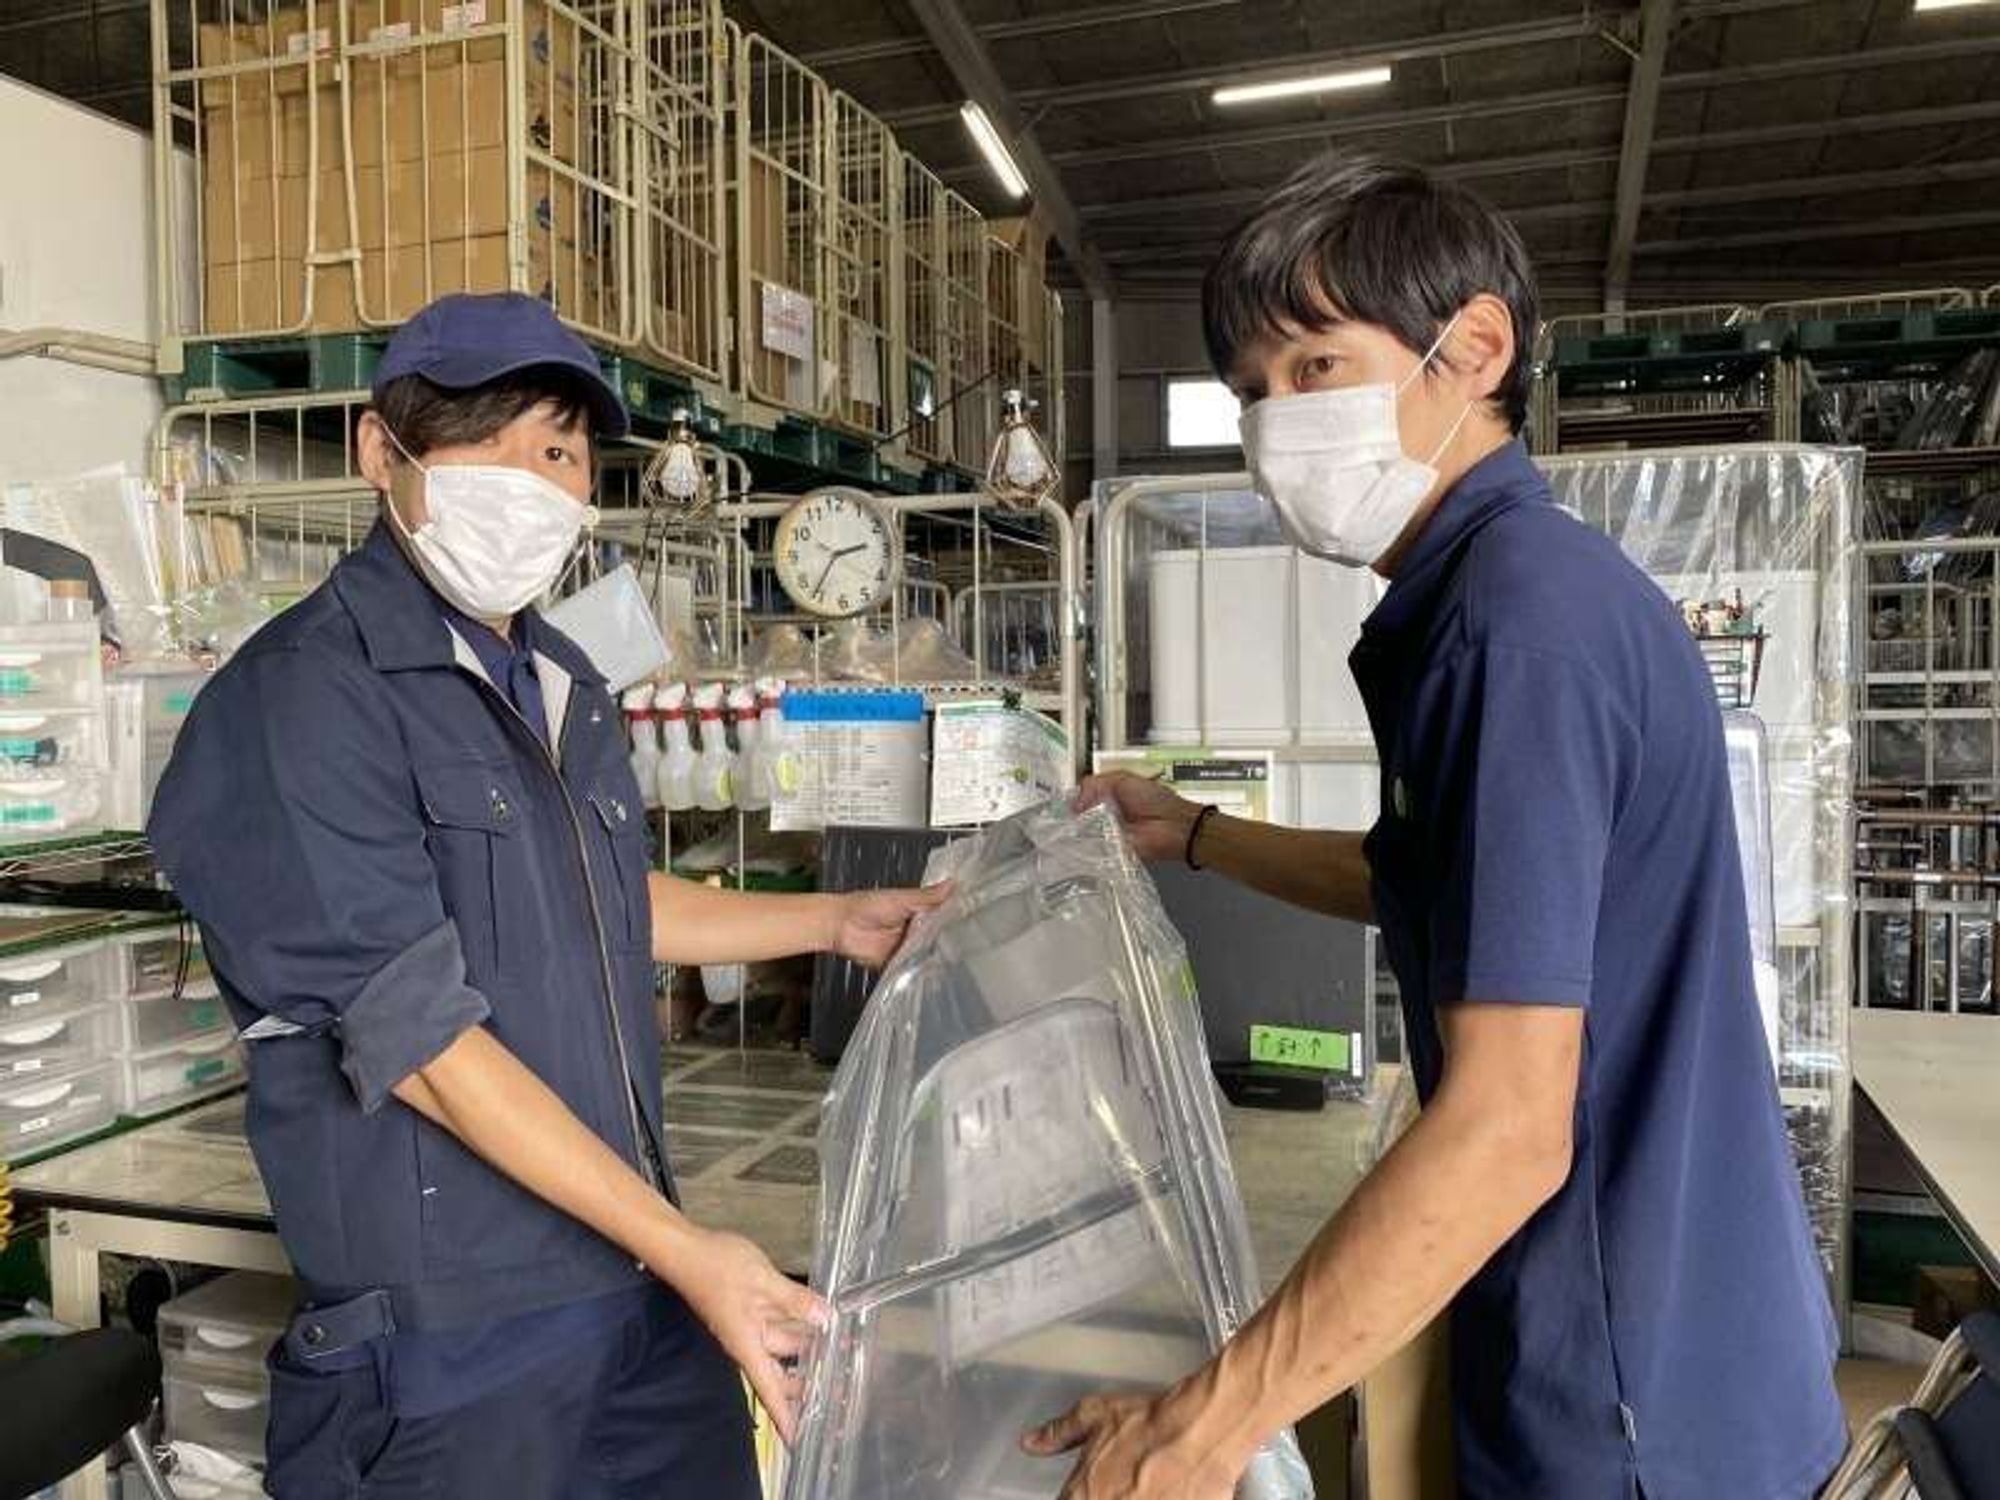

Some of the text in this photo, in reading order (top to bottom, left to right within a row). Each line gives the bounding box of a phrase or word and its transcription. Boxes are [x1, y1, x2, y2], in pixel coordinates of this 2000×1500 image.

[825, 495, 844, 512] 12
[856, 501, 863, 518] 1
[807, 506, 822, 521] 11
[871, 517, 882, 534] 2
[792, 526, 811, 541] 10
[882, 541, 892, 559] 3
[874, 569, 885, 581] 4
[839, 594, 850, 609] 6
[860, 587, 871, 601] 5
